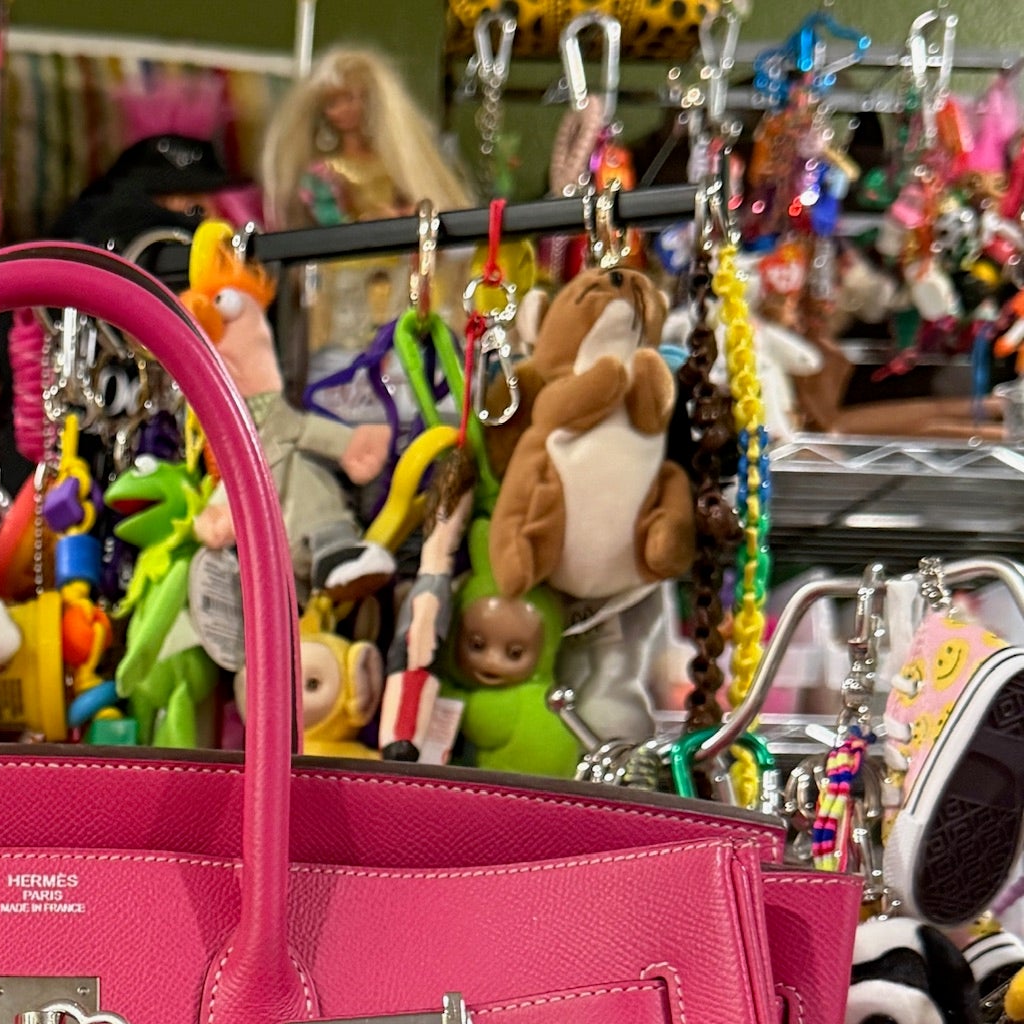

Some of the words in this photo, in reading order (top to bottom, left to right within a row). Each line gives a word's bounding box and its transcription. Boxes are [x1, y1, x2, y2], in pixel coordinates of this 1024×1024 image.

[22, 890, 63, 901] PARIS
[0, 903, 30, 913] MADE
[31, 903, 42, 913] IN
[43, 903, 86, 913] FRANCE
